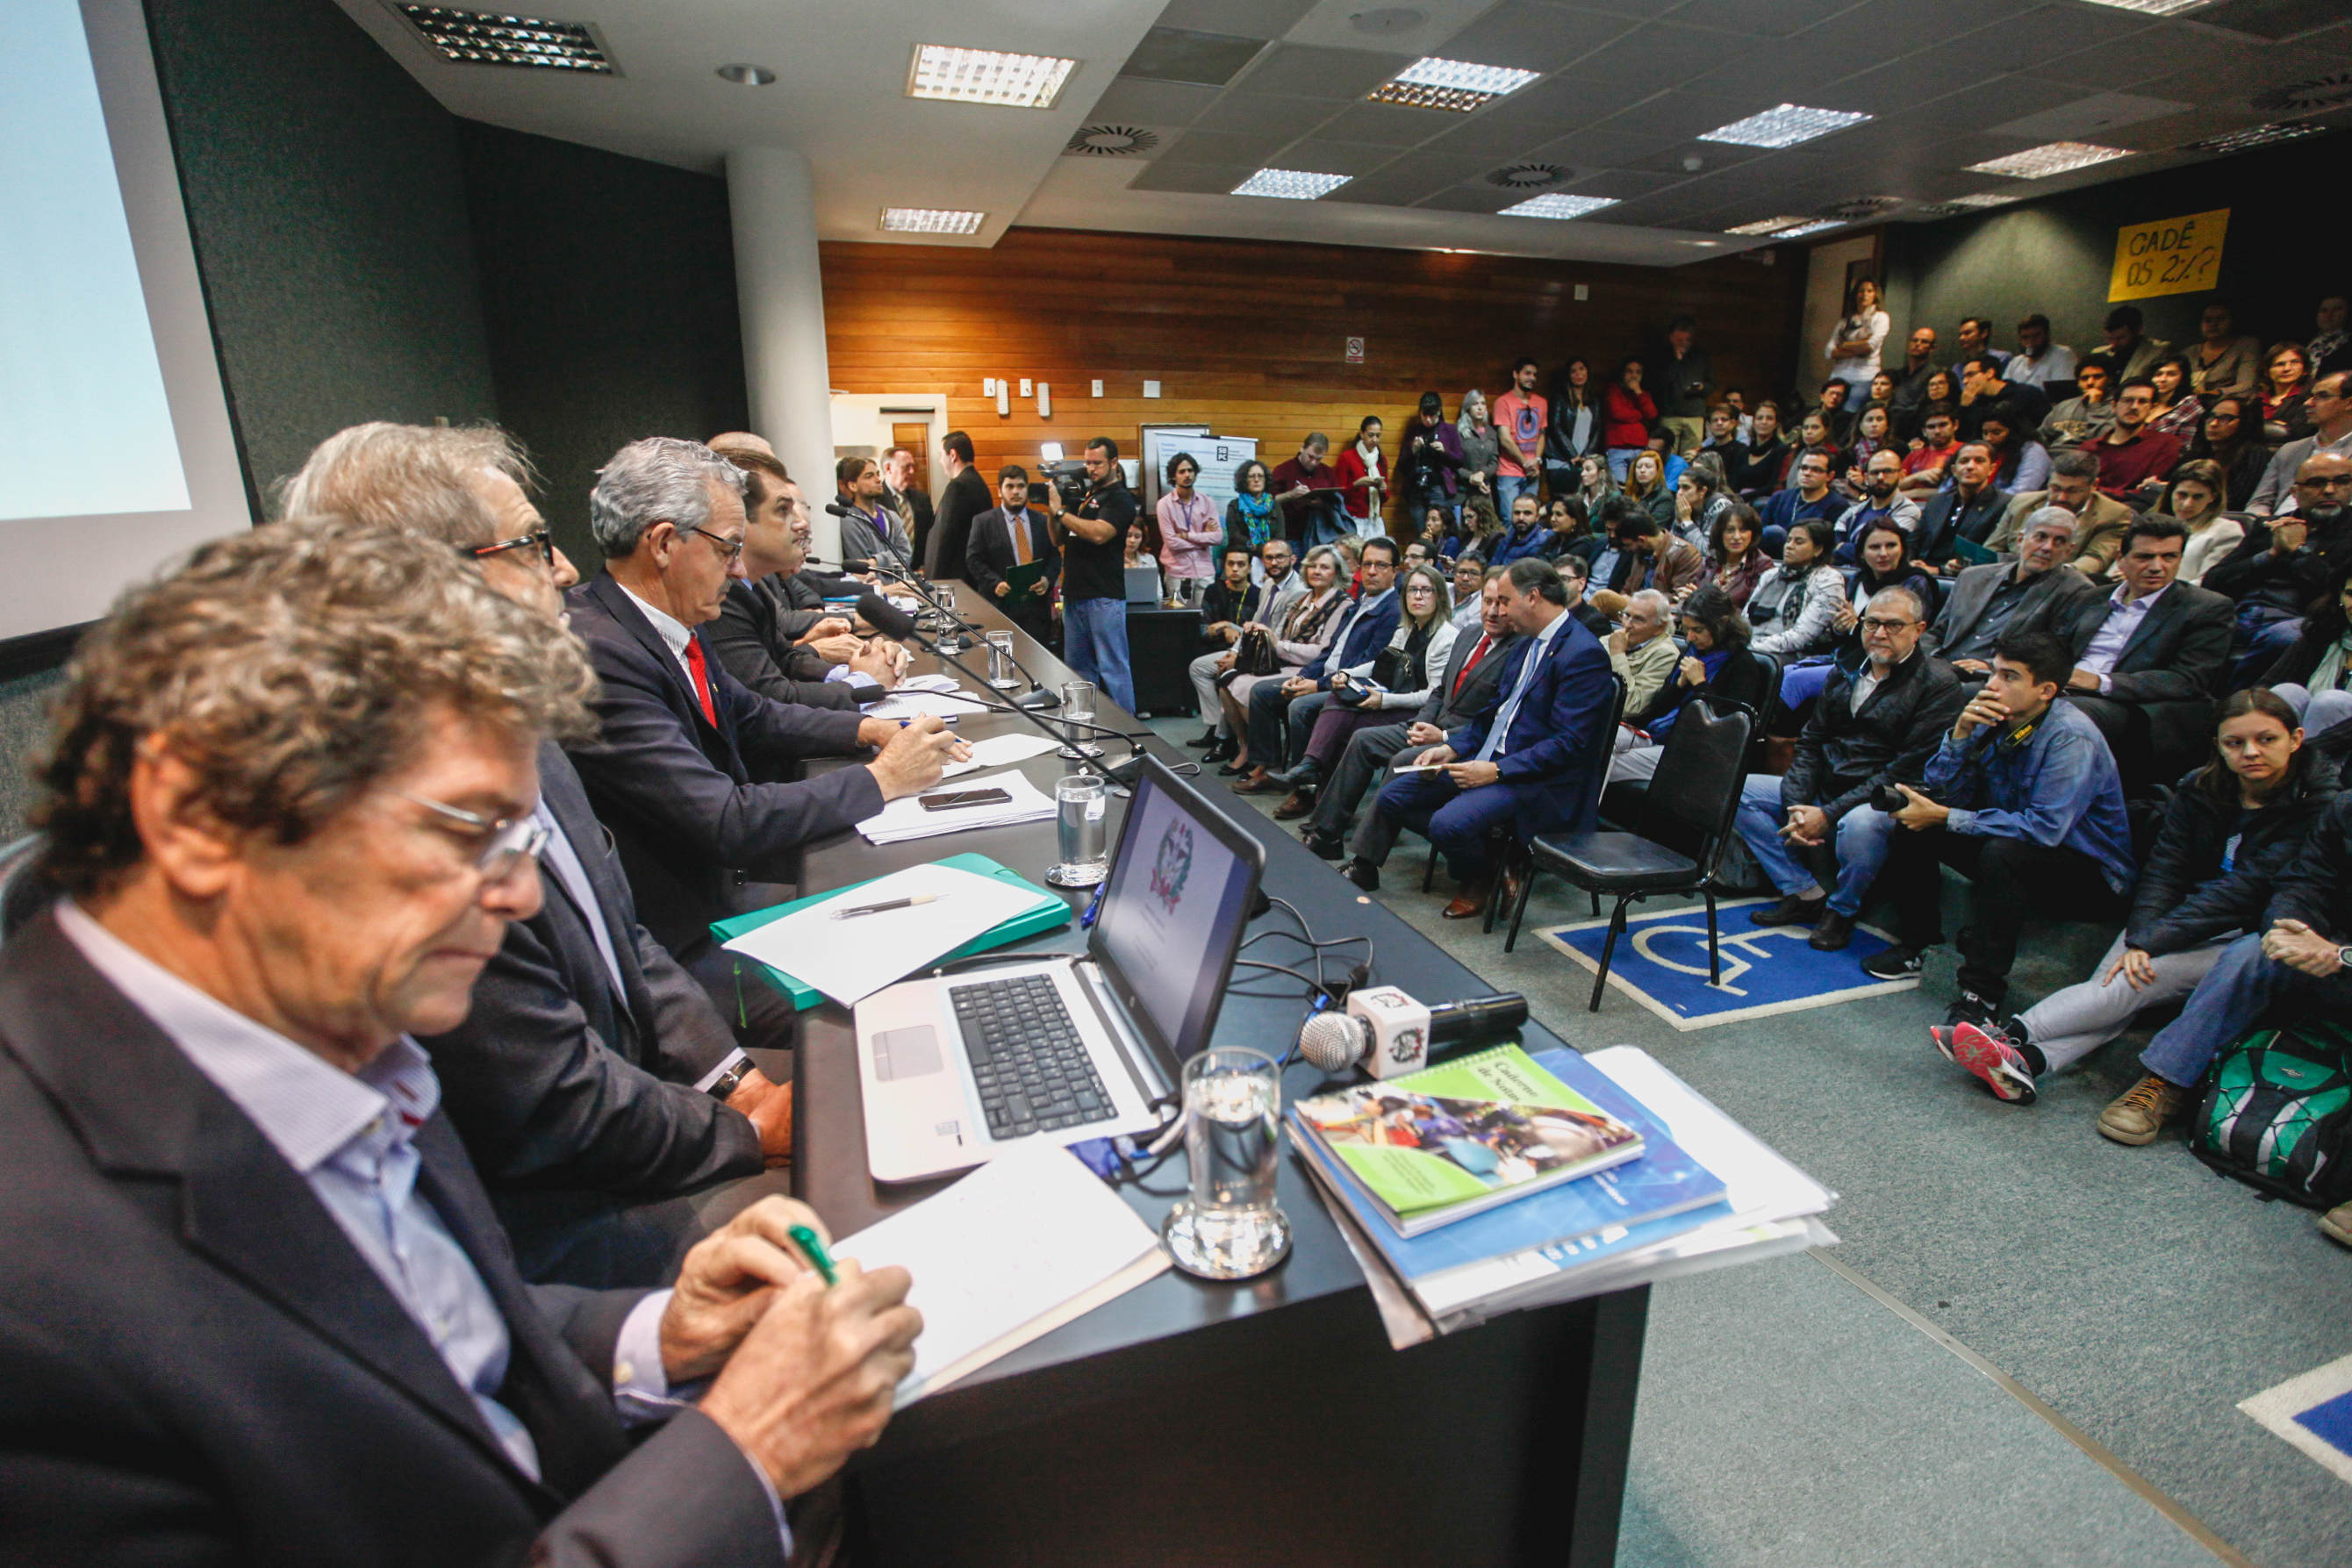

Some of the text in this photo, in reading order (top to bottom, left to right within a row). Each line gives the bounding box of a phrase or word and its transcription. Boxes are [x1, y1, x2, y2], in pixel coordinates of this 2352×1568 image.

[2126, 259, 2155, 287] OS
[2014, 724, 2033, 740] Nikon
[1477, 1067, 1520, 1103] de Notas
[1495, 1061, 1538, 1098] Caderno
